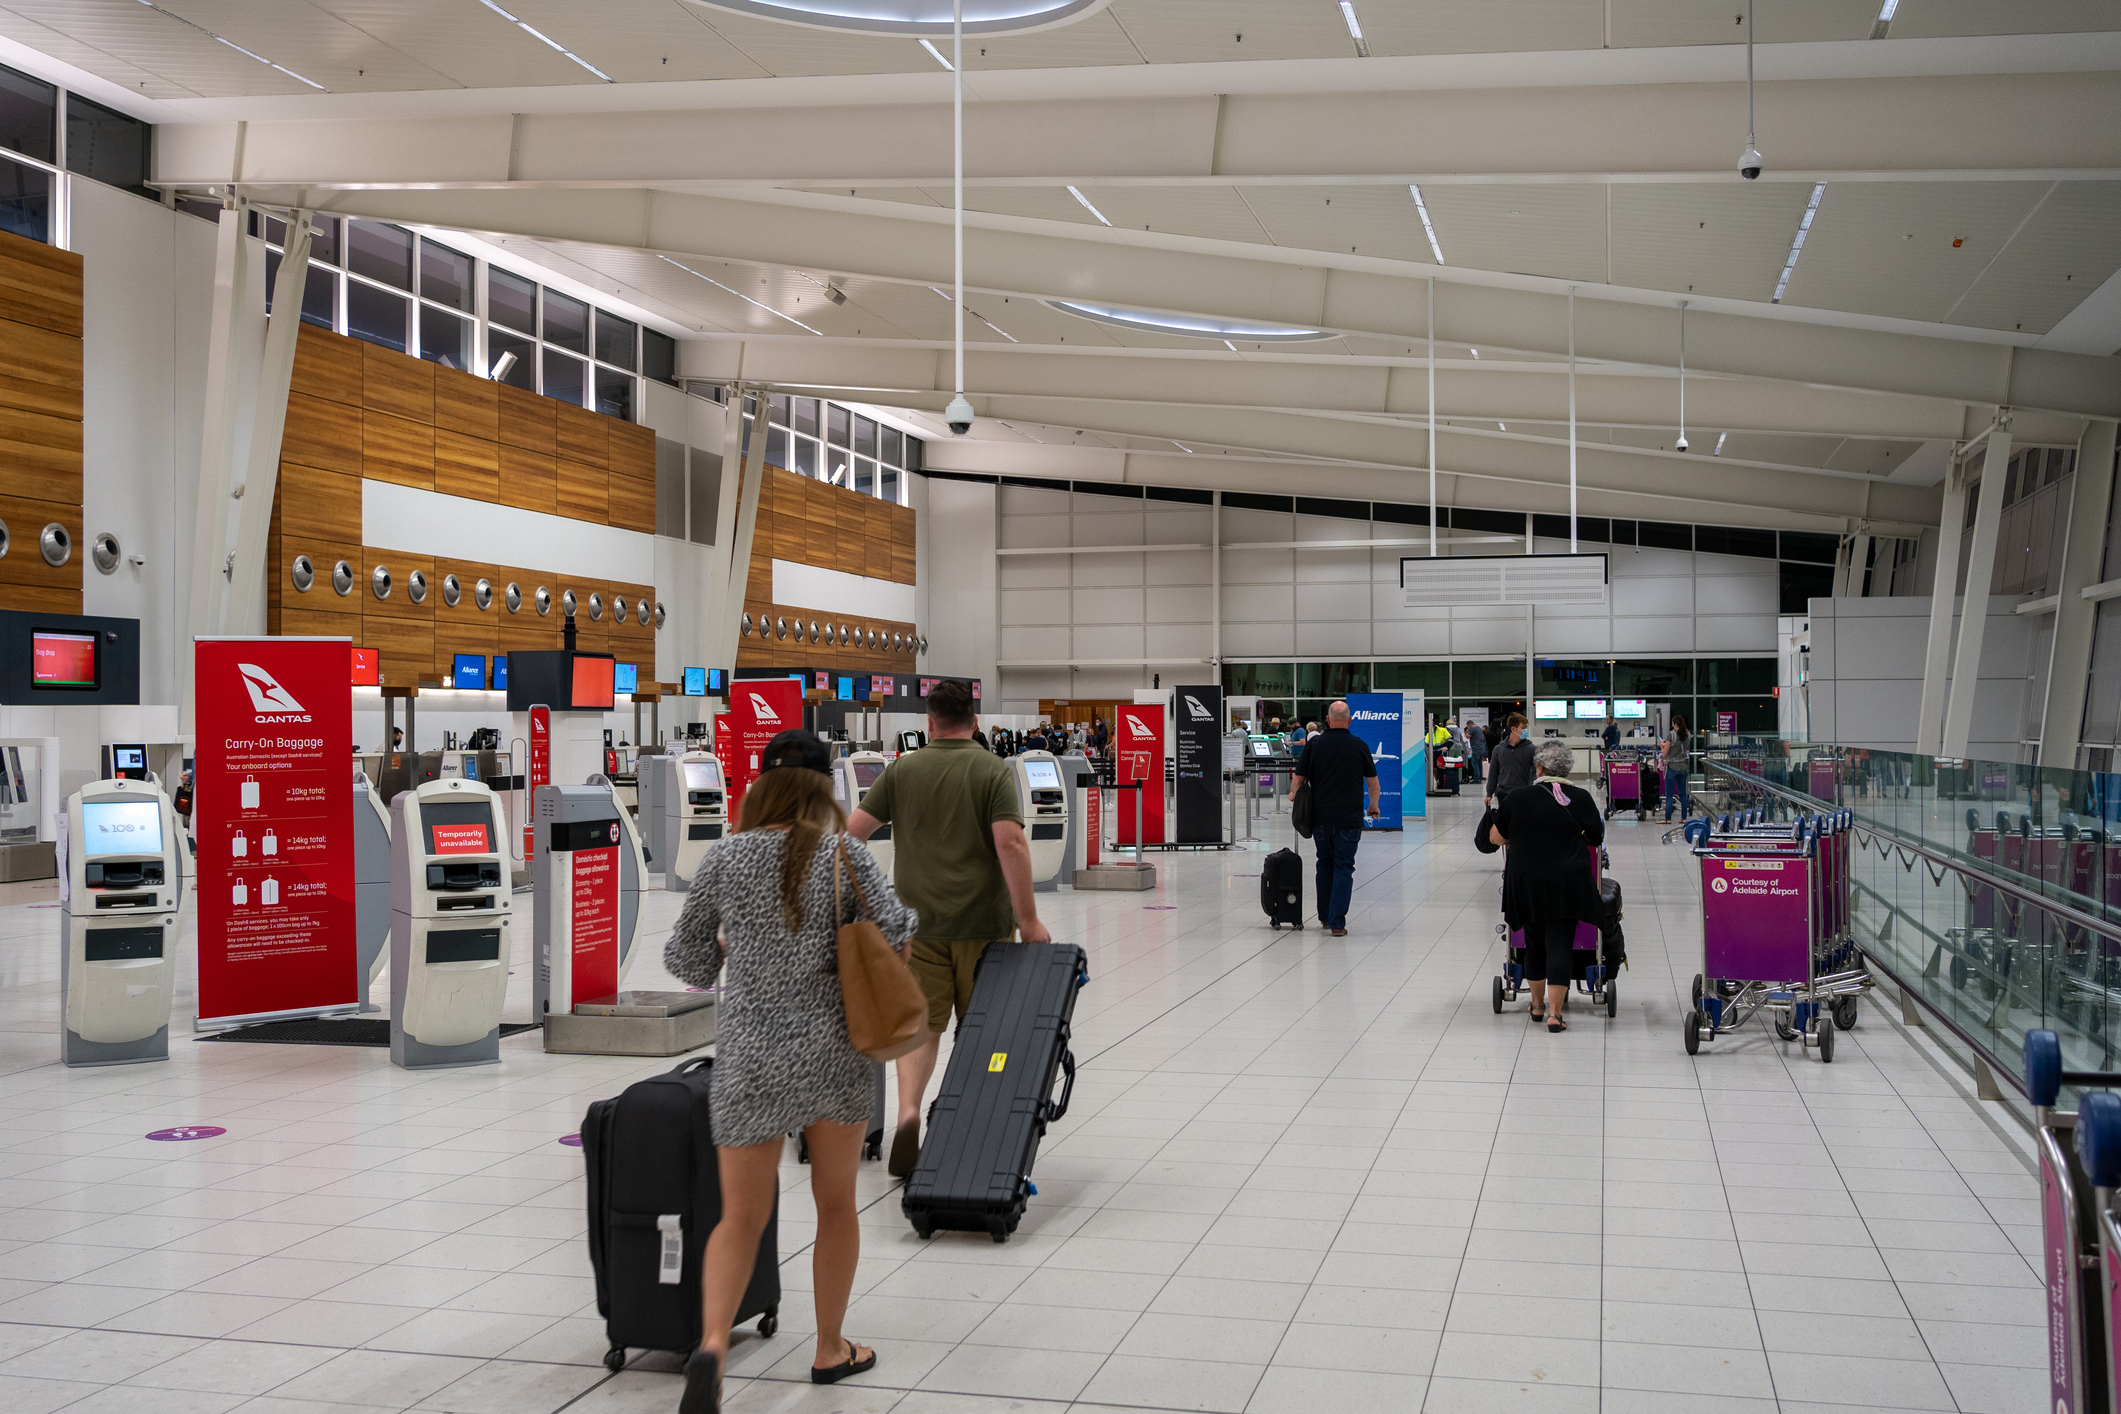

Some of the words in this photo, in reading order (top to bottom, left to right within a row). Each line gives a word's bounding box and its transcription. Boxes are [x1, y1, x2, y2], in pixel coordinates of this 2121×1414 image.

[36, 649, 44, 657] Bag
[46, 649, 55, 657] drop
[255, 715, 312, 724] QANTAS
[1352, 711, 1399, 720] Alliance
[225, 738, 274, 751] Carry-On
[277, 738, 324, 750] Baggage
[438, 830, 482, 838] Temporarily
[576, 855, 592, 863] Domestic
[593, 853, 608, 861] checked
[1732, 878, 1768, 887] Courtesy
[1770, 887, 1798, 896] Airport
[2051, 1285, 2057, 1303] of
